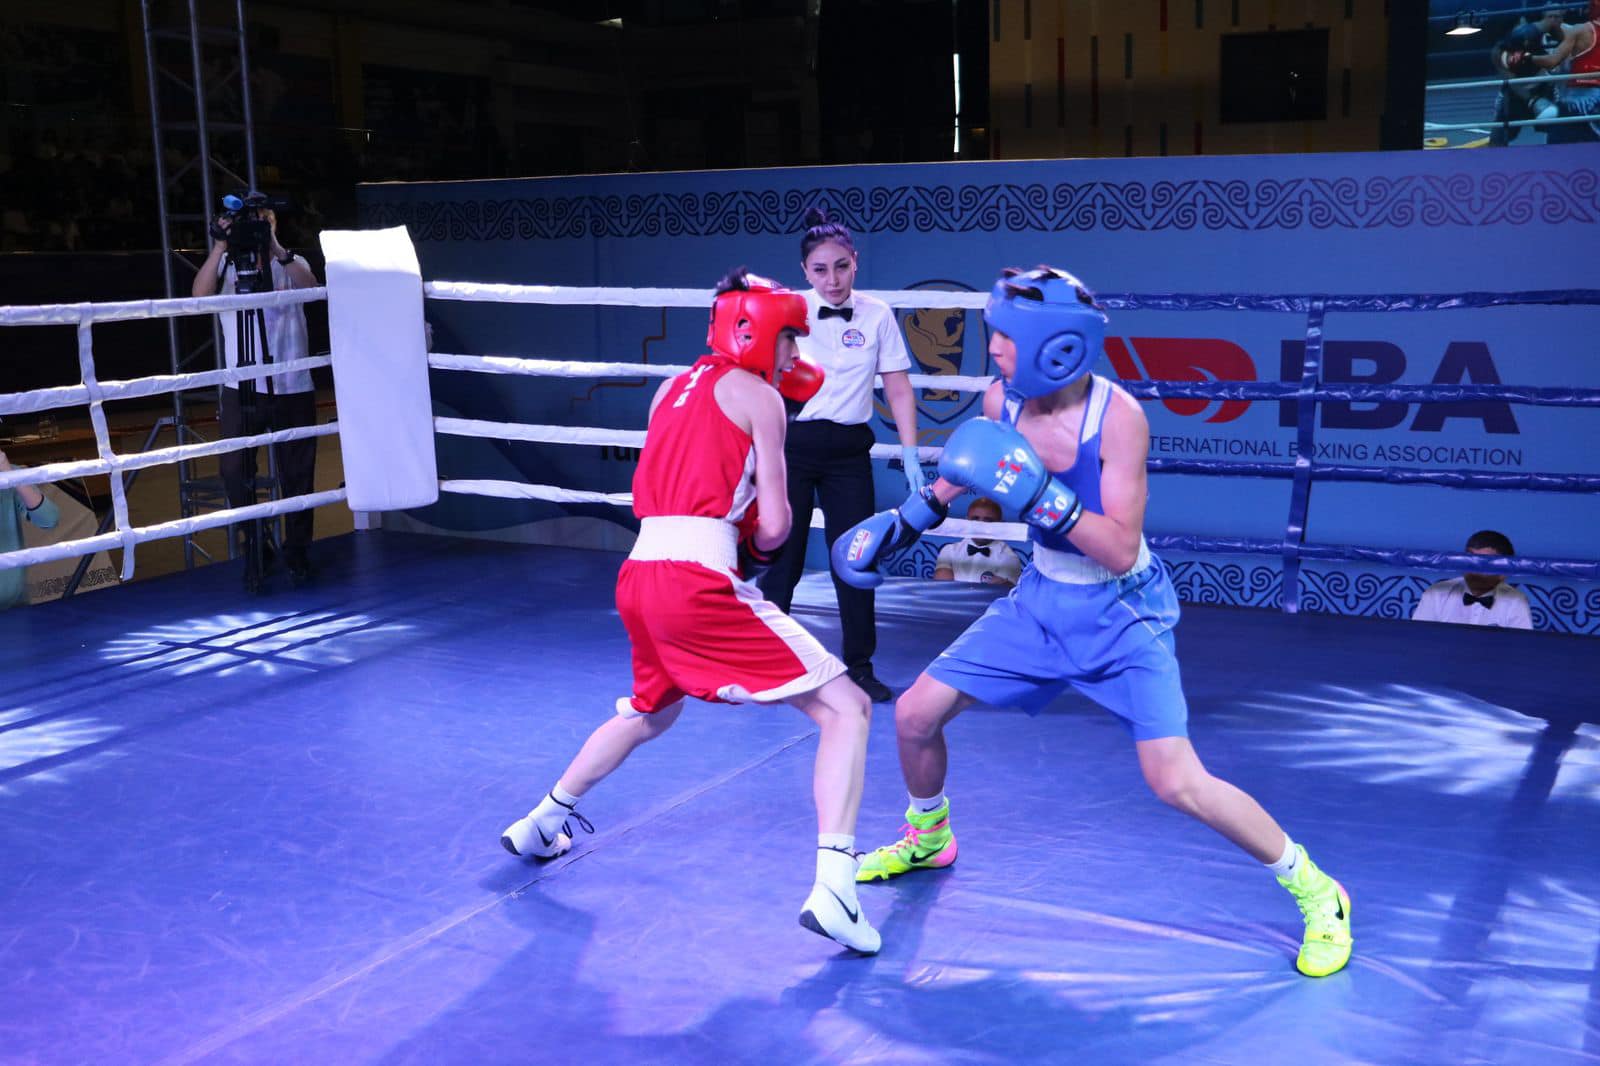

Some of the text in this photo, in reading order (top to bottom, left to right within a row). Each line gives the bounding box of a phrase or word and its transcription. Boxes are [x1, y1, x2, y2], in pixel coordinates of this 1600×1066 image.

[1279, 340, 1521, 434] IBA
[1148, 435, 1522, 467] TERNATIONAL BXING ASSOCIATION
[993, 448, 1028, 494] VELO
[1039, 496, 1068, 527] ELO
